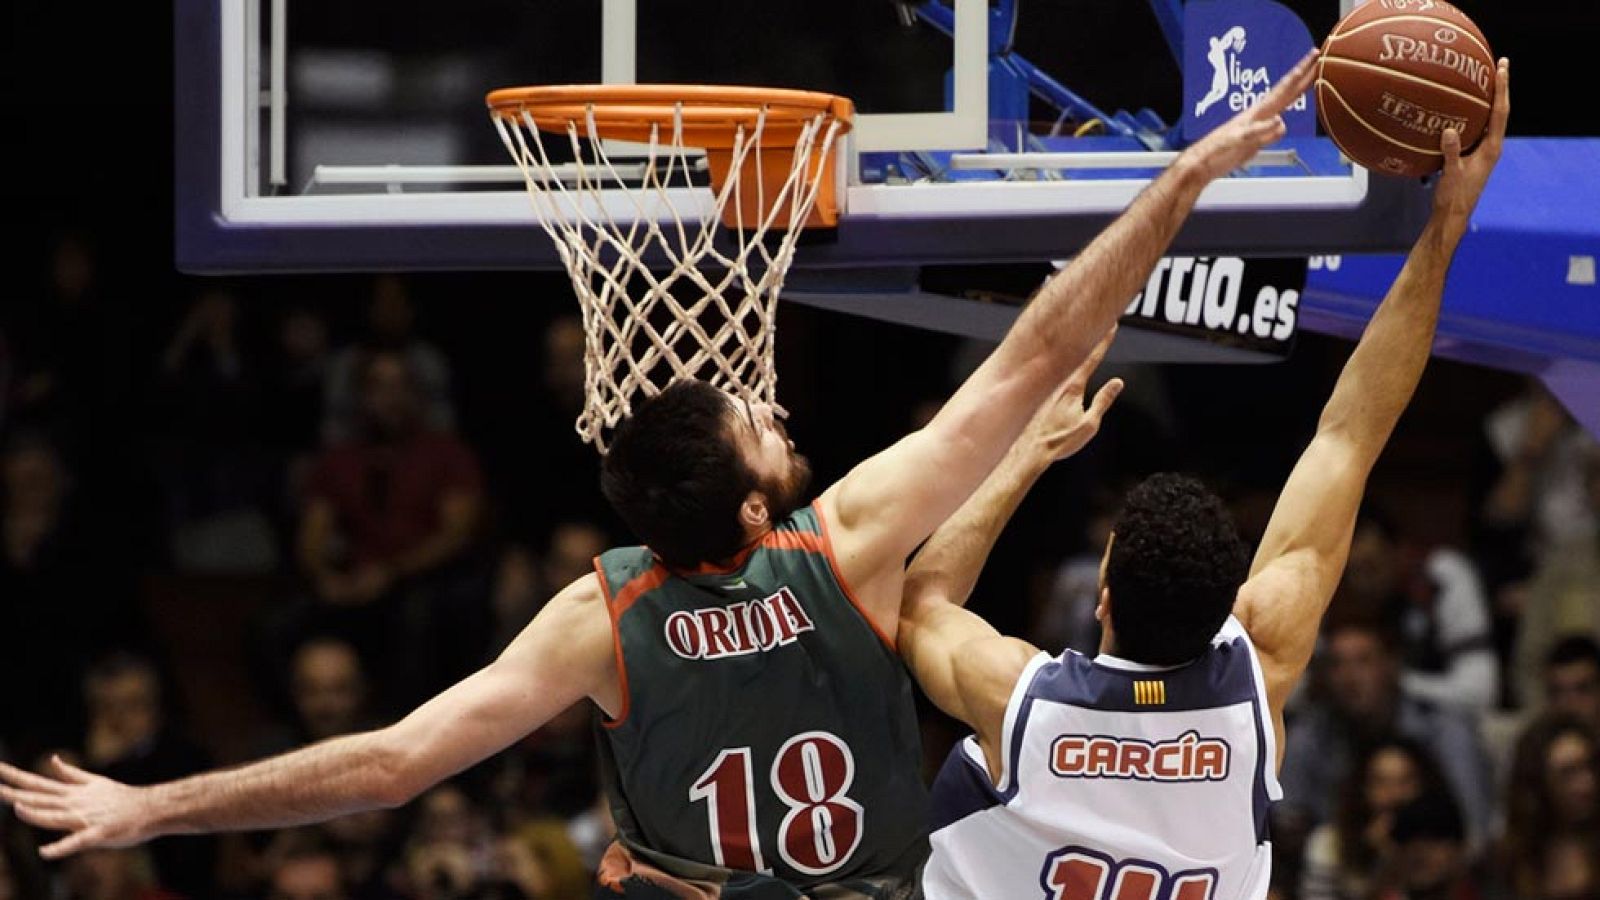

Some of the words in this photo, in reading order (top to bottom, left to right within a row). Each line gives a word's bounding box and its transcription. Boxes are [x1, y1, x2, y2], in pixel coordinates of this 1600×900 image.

[1230, 52, 1270, 92] liga
[1380, 33, 1490, 98] SPALDING
[1049, 729, 1231, 782] GARCÍA
[689, 730, 865, 877] 18
